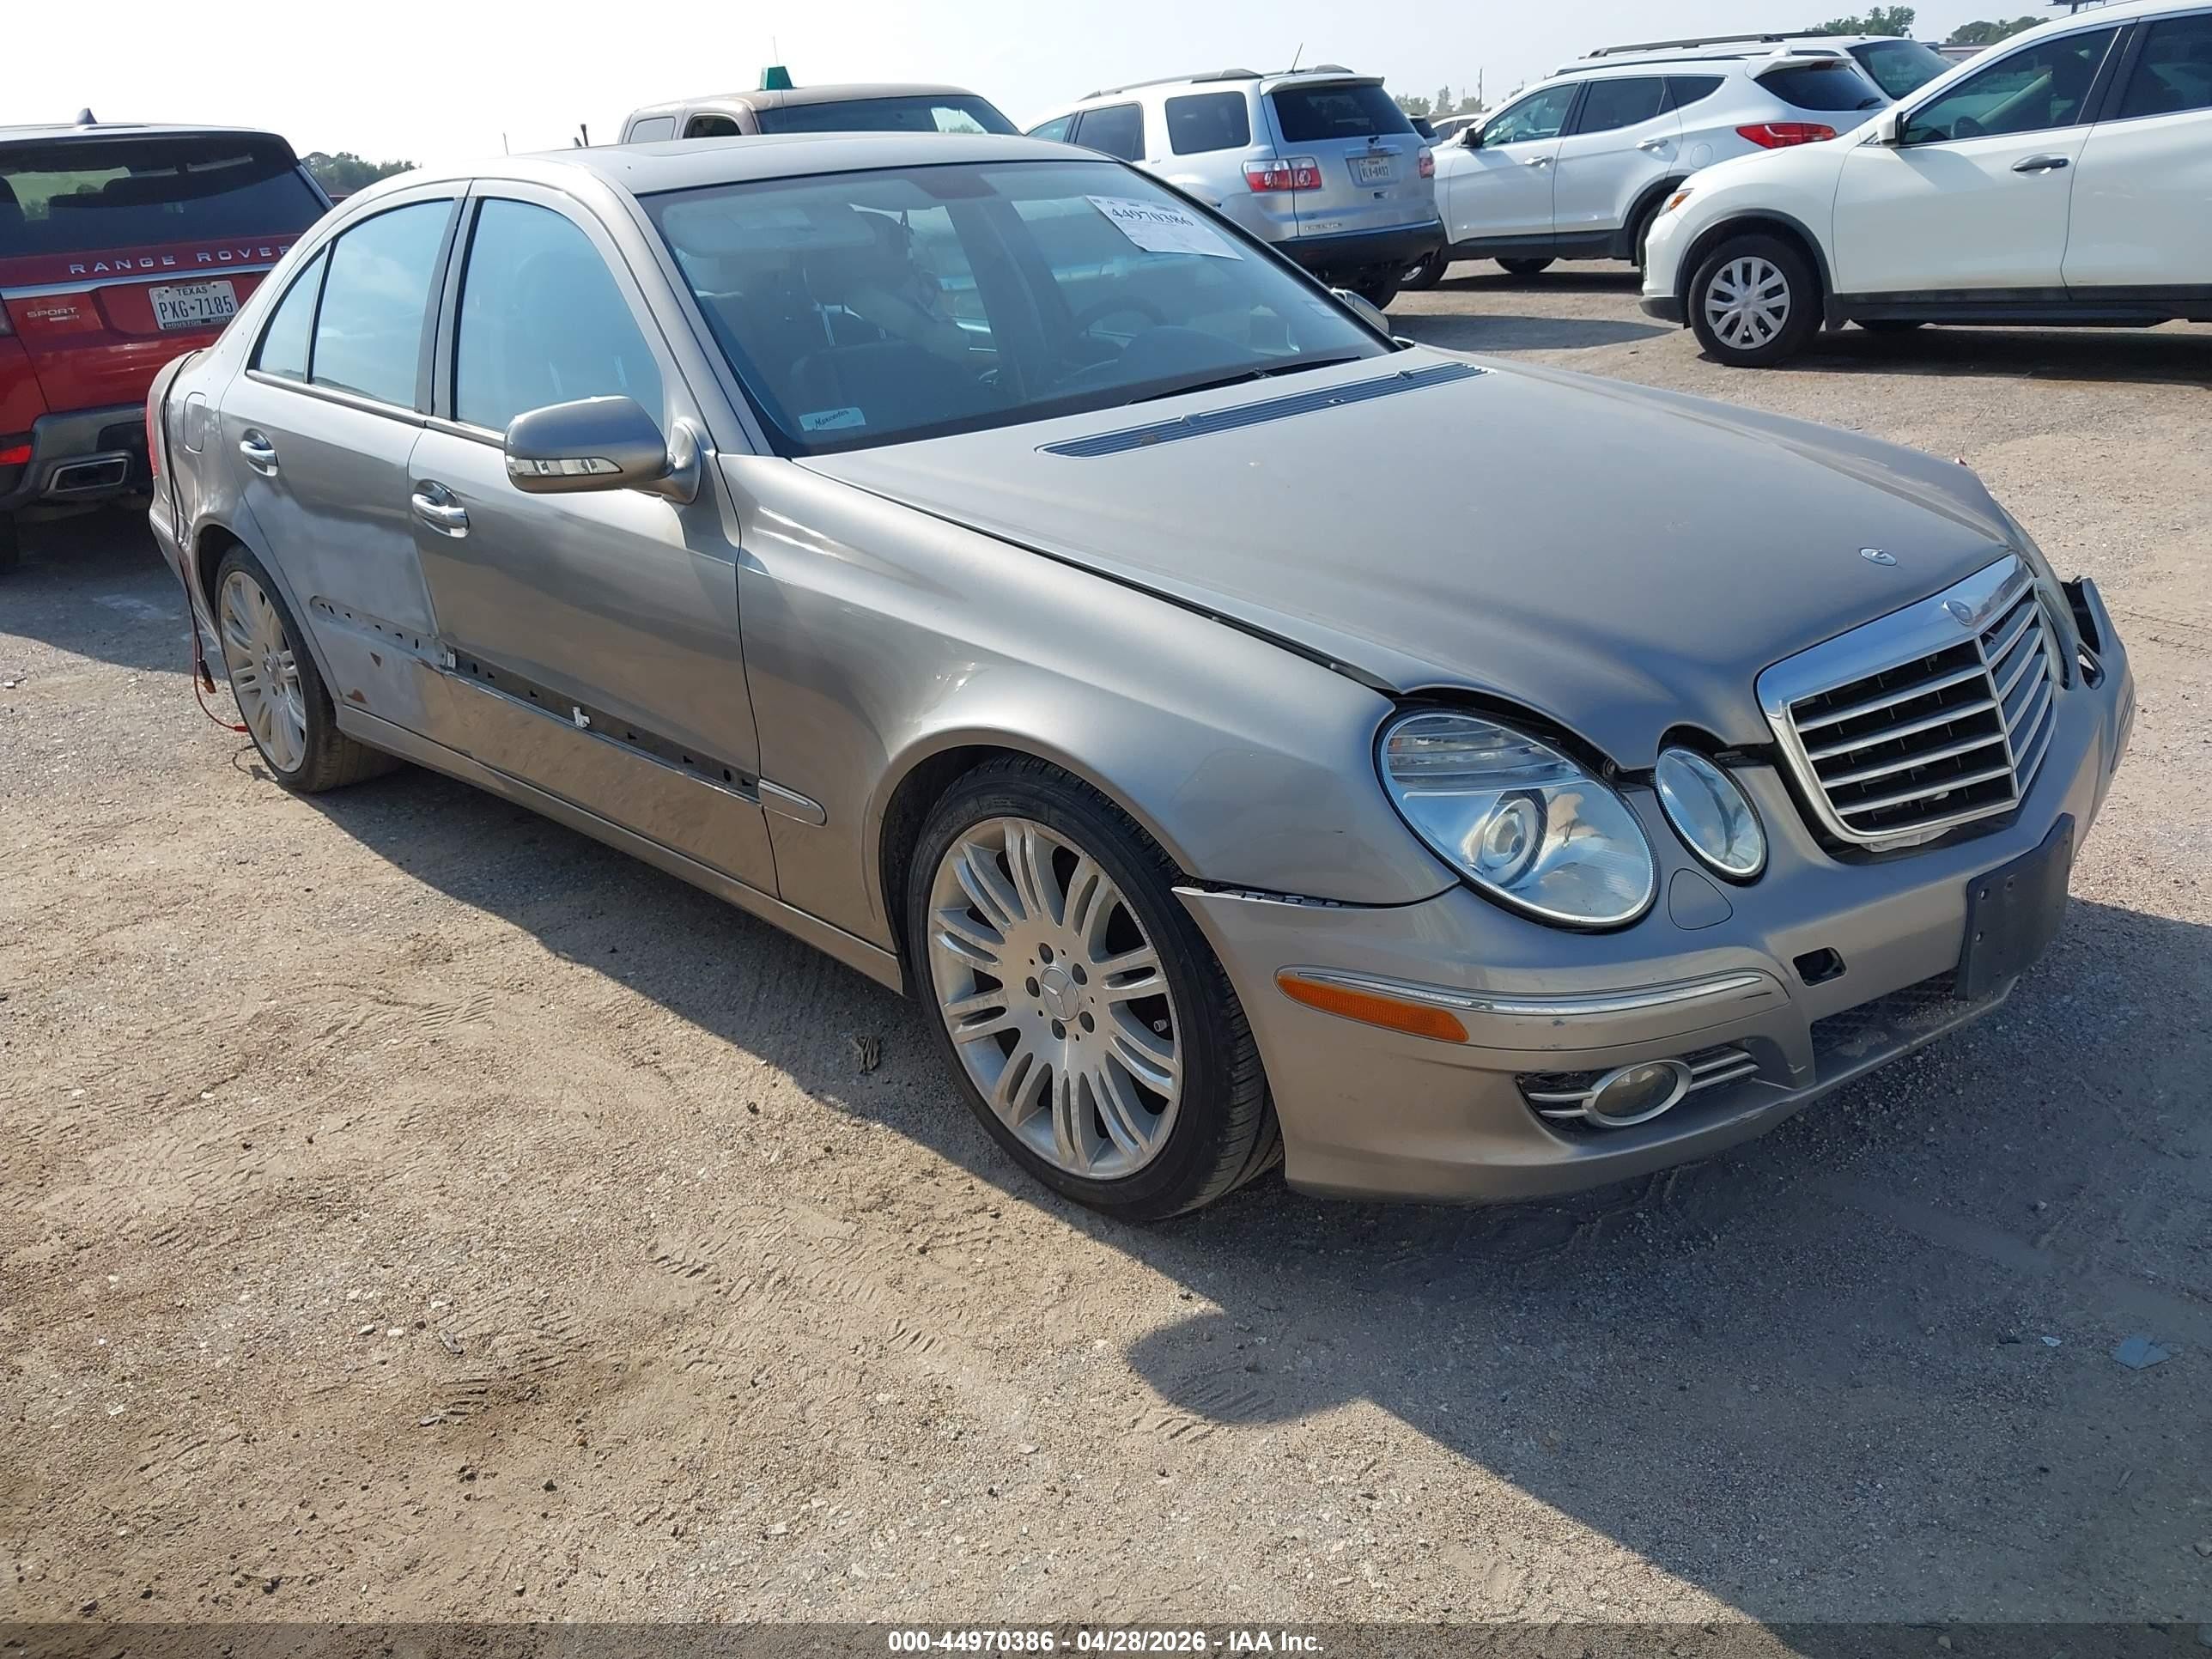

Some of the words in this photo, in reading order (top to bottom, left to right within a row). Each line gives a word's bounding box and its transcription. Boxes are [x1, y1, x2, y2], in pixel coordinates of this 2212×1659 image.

[1112, 208, 1194, 227] 44970386
[70, 255, 176, 274] RANGE
[176, 286, 208, 296] TEXAS
[27, 307, 77, 318] SPORT
